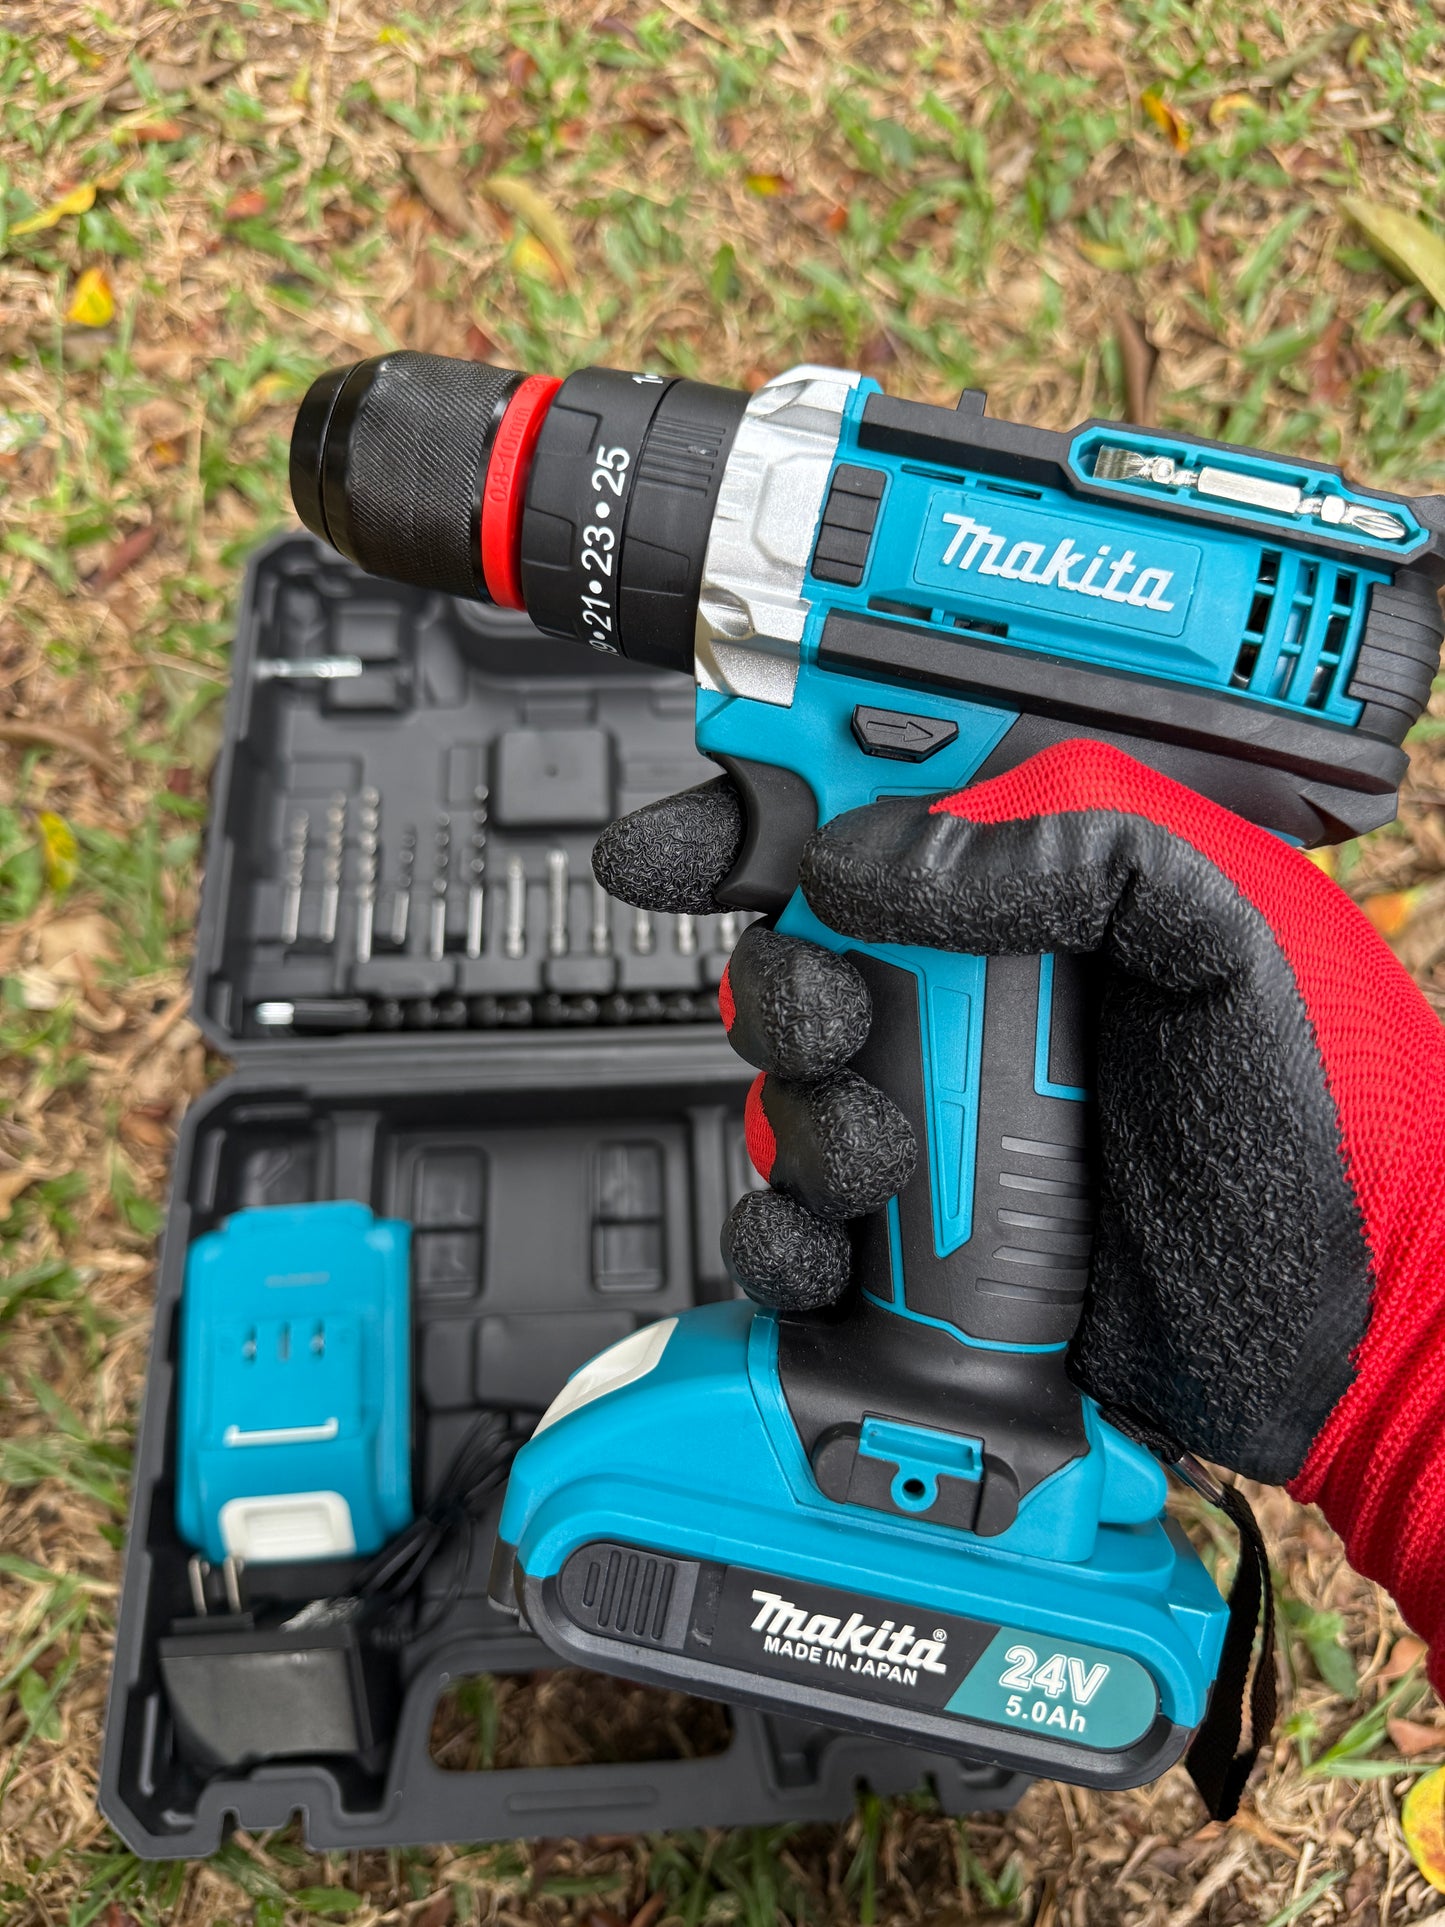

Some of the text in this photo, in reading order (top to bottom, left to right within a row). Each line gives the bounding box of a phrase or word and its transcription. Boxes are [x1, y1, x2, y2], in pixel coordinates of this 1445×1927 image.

[591, 445, 630, 496] 25
[581, 525, 615, 577] 23
[581, 595, 612, 632] 21
[763, 1635, 918, 1687] MADE IN JAPAN
[999, 1645, 1110, 1706] 24V
[1006, 1695, 1087, 1734] 5.0Ah
